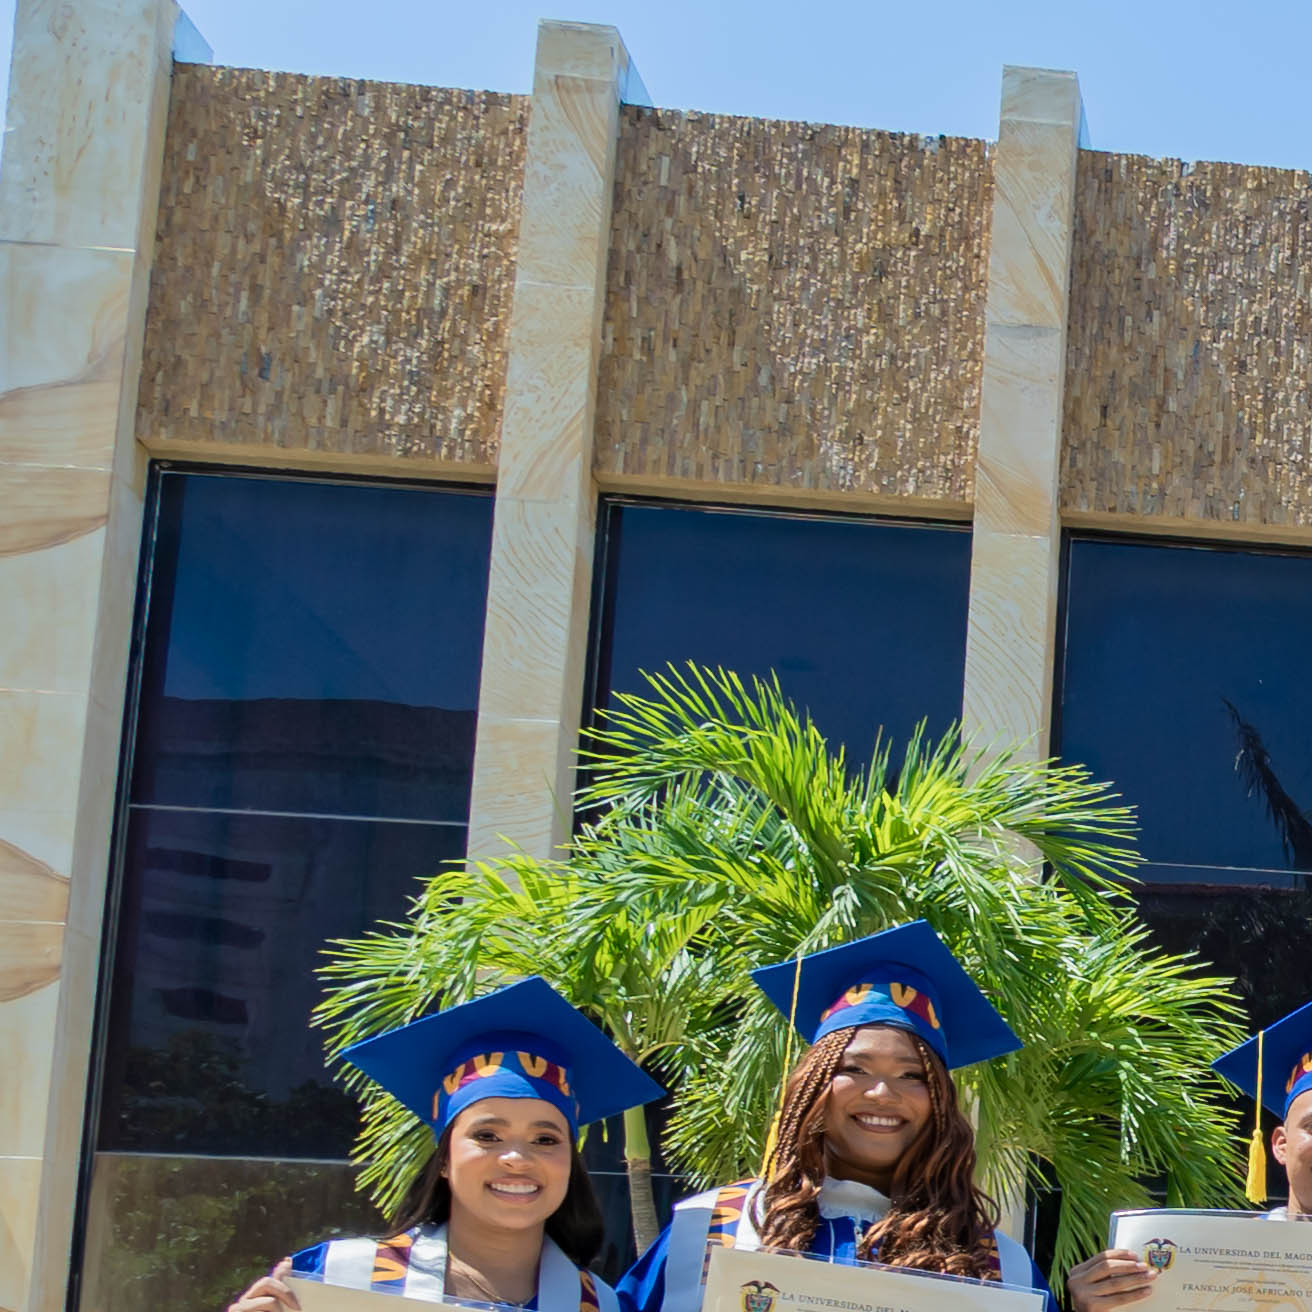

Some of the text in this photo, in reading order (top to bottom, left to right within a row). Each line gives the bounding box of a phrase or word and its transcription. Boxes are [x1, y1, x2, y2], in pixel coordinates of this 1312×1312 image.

[1180, 1246, 1191, 1254] LA
[1194, 1247, 1260, 1258] UNIVERSIDAD
[1264, 1250, 1281, 1260] DEL
[1182, 1284, 1228, 1293] FRANKLIN
[1256, 1288, 1302, 1297] AFRICANO
[782, 1293, 794, 1301] LA
[799, 1295, 872, 1312] UNIVERSIDAD
